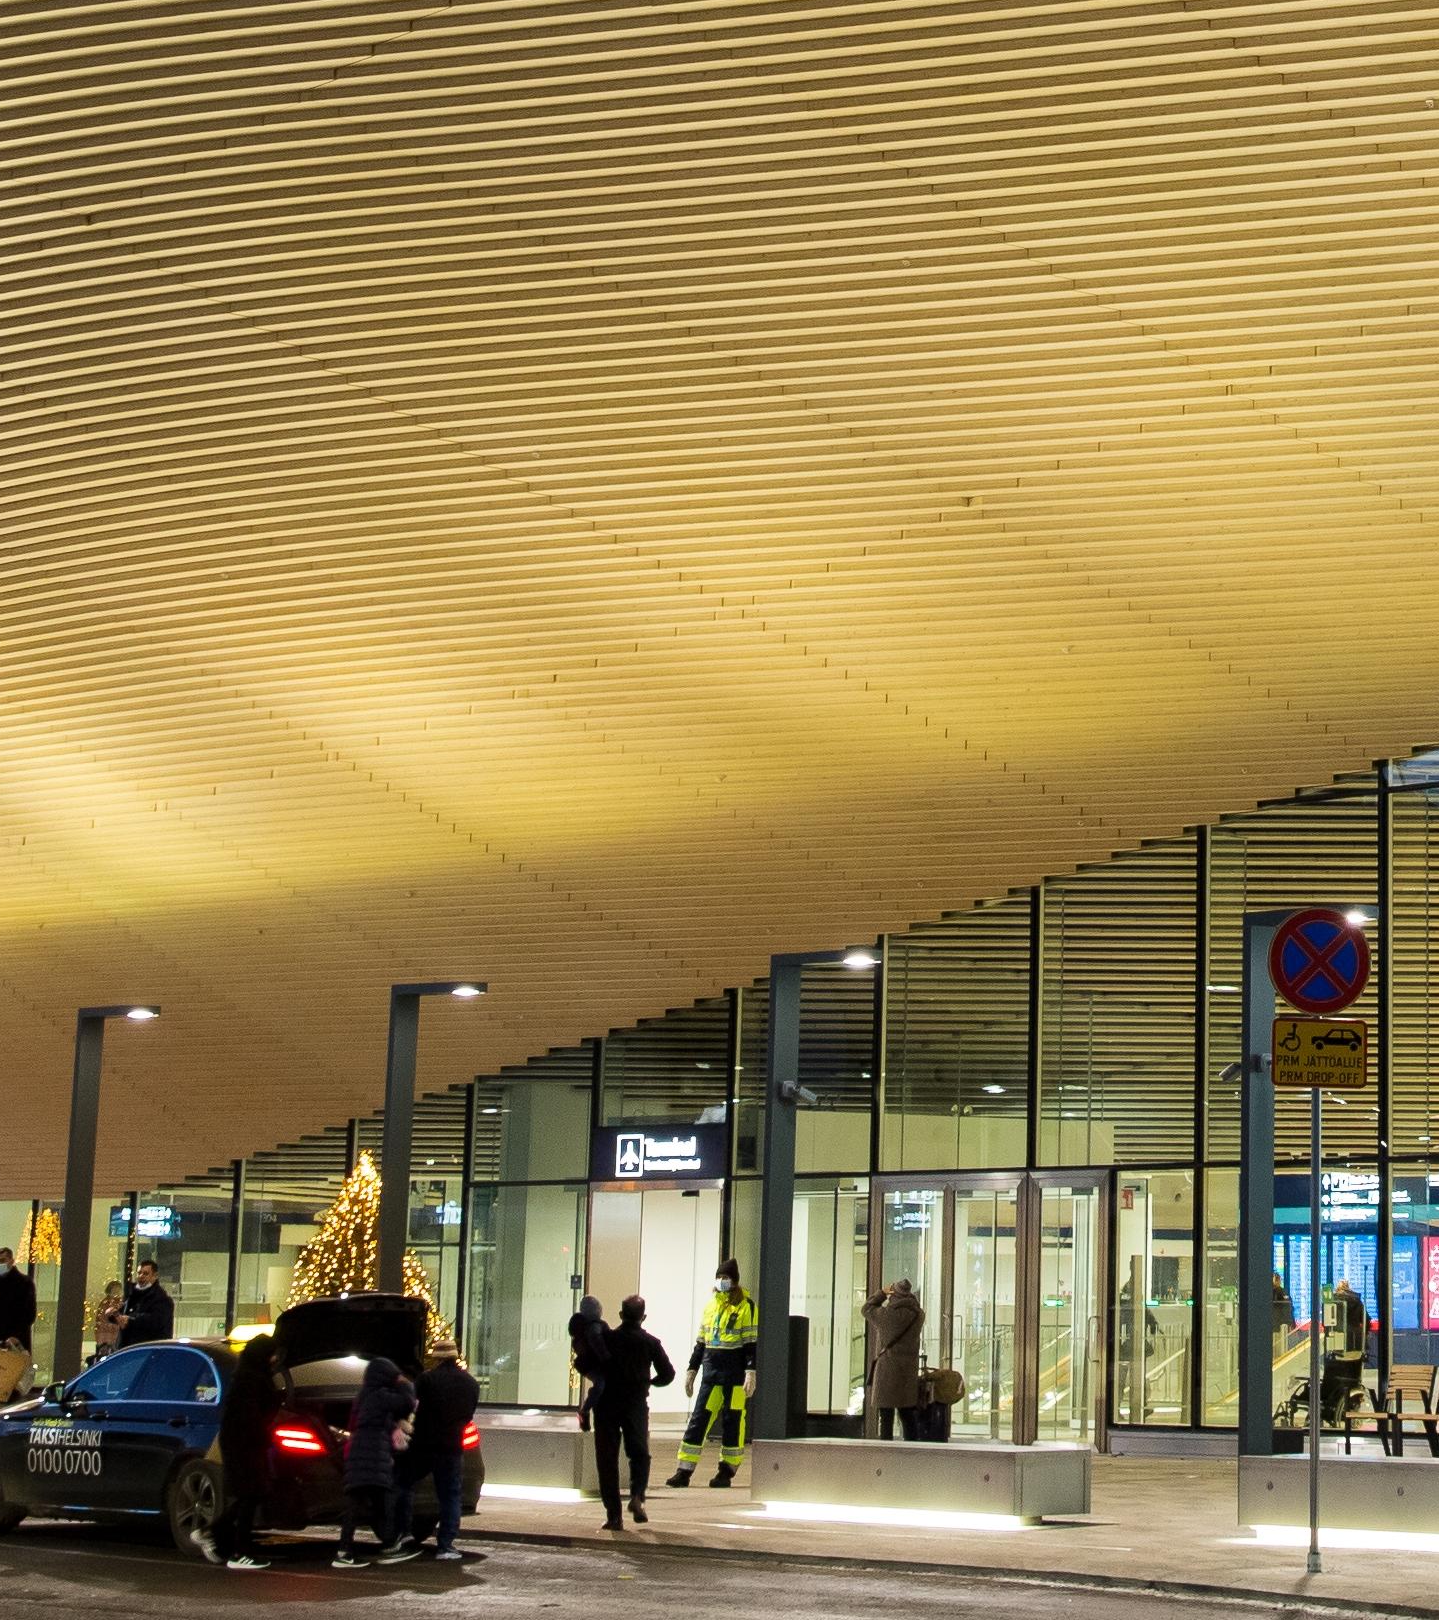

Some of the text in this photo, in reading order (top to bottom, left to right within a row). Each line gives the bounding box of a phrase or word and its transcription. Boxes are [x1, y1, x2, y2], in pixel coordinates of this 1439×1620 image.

[1277, 1055, 1300, 1067] PRM
[1280, 1070, 1361, 1084] PRM DROP-OFF
[27, 1447, 102, 1476] 0100 0700
